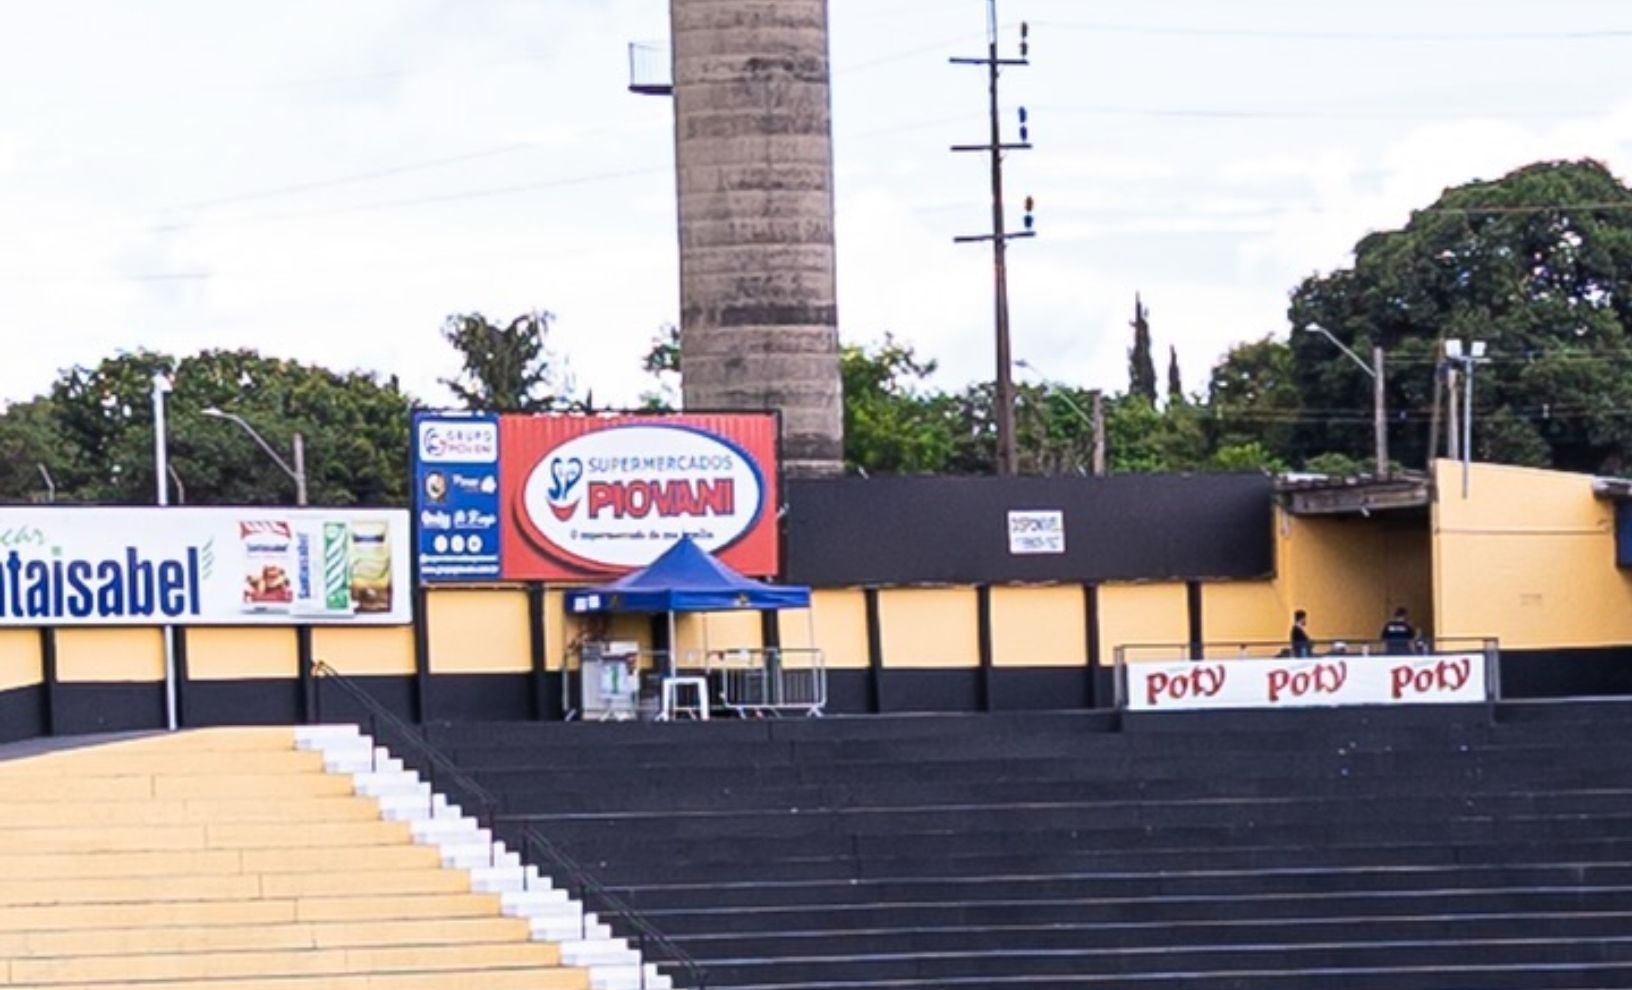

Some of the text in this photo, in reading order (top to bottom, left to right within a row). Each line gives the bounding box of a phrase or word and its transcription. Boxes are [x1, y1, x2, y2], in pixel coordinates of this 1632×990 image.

[588, 455, 733, 473] SUPERMERCADOS
[588, 478, 735, 519] PIOVANI
[0, 546, 200, 618] taisabel
[1146, 665, 1226, 705] Poty
[1266, 661, 1347, 702] Poty
[1390, 658, 1471, 701] Poty
